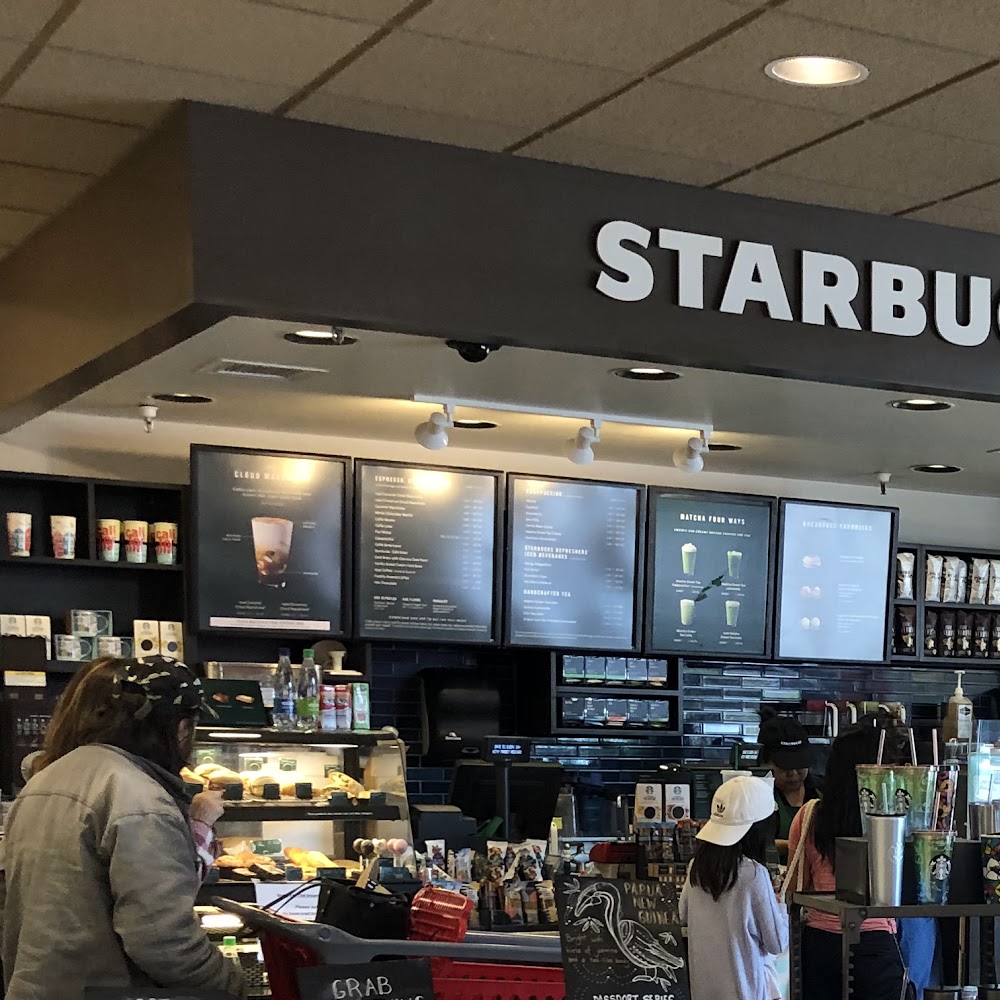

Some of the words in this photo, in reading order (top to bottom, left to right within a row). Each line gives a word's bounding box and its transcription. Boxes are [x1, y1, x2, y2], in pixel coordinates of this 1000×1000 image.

[680, 513, 706, 522] MATCHA
[708, 515, 725, 524] FOUR
[728, 517, 746, 526] WAYS
[624, 881, 664, 897] PAPUA
[632, 896, 657, 910] NEW
[638, 910, 680, 925] GUINEA
[331, 976, 393, 999] GRAB
